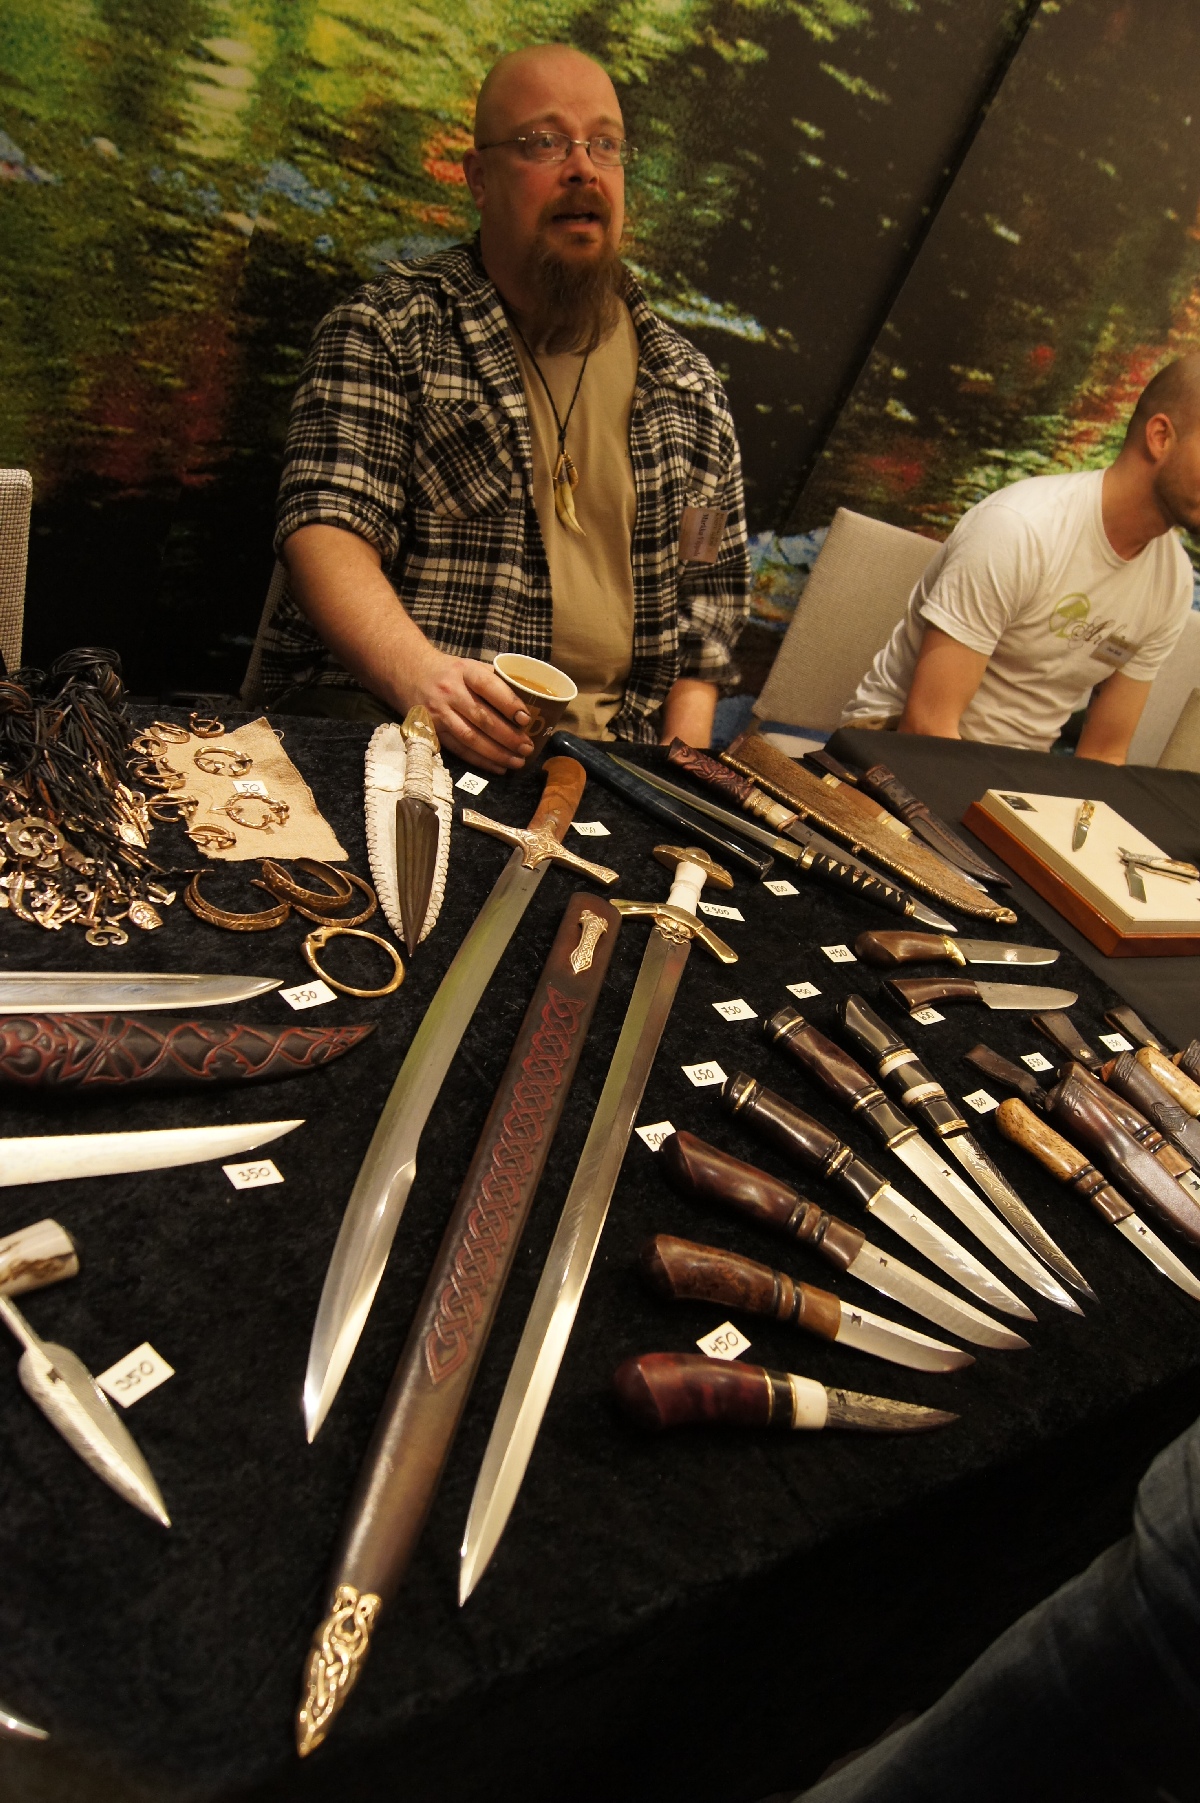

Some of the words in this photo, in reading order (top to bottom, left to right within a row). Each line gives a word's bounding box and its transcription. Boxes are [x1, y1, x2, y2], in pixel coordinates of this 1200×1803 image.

[241, 783, 261, 793] 50
[828, 948, 848, 958] 450
[289, 990, 318, 1003] 750
[720, 1005, 742, 1016] 750
[692, 1068, 715, 1081] 650
[237, 1167, 271, 1182] 350
[708, 1331, 739, 1355] 450
[114, 1360, 155, 1391] 350
